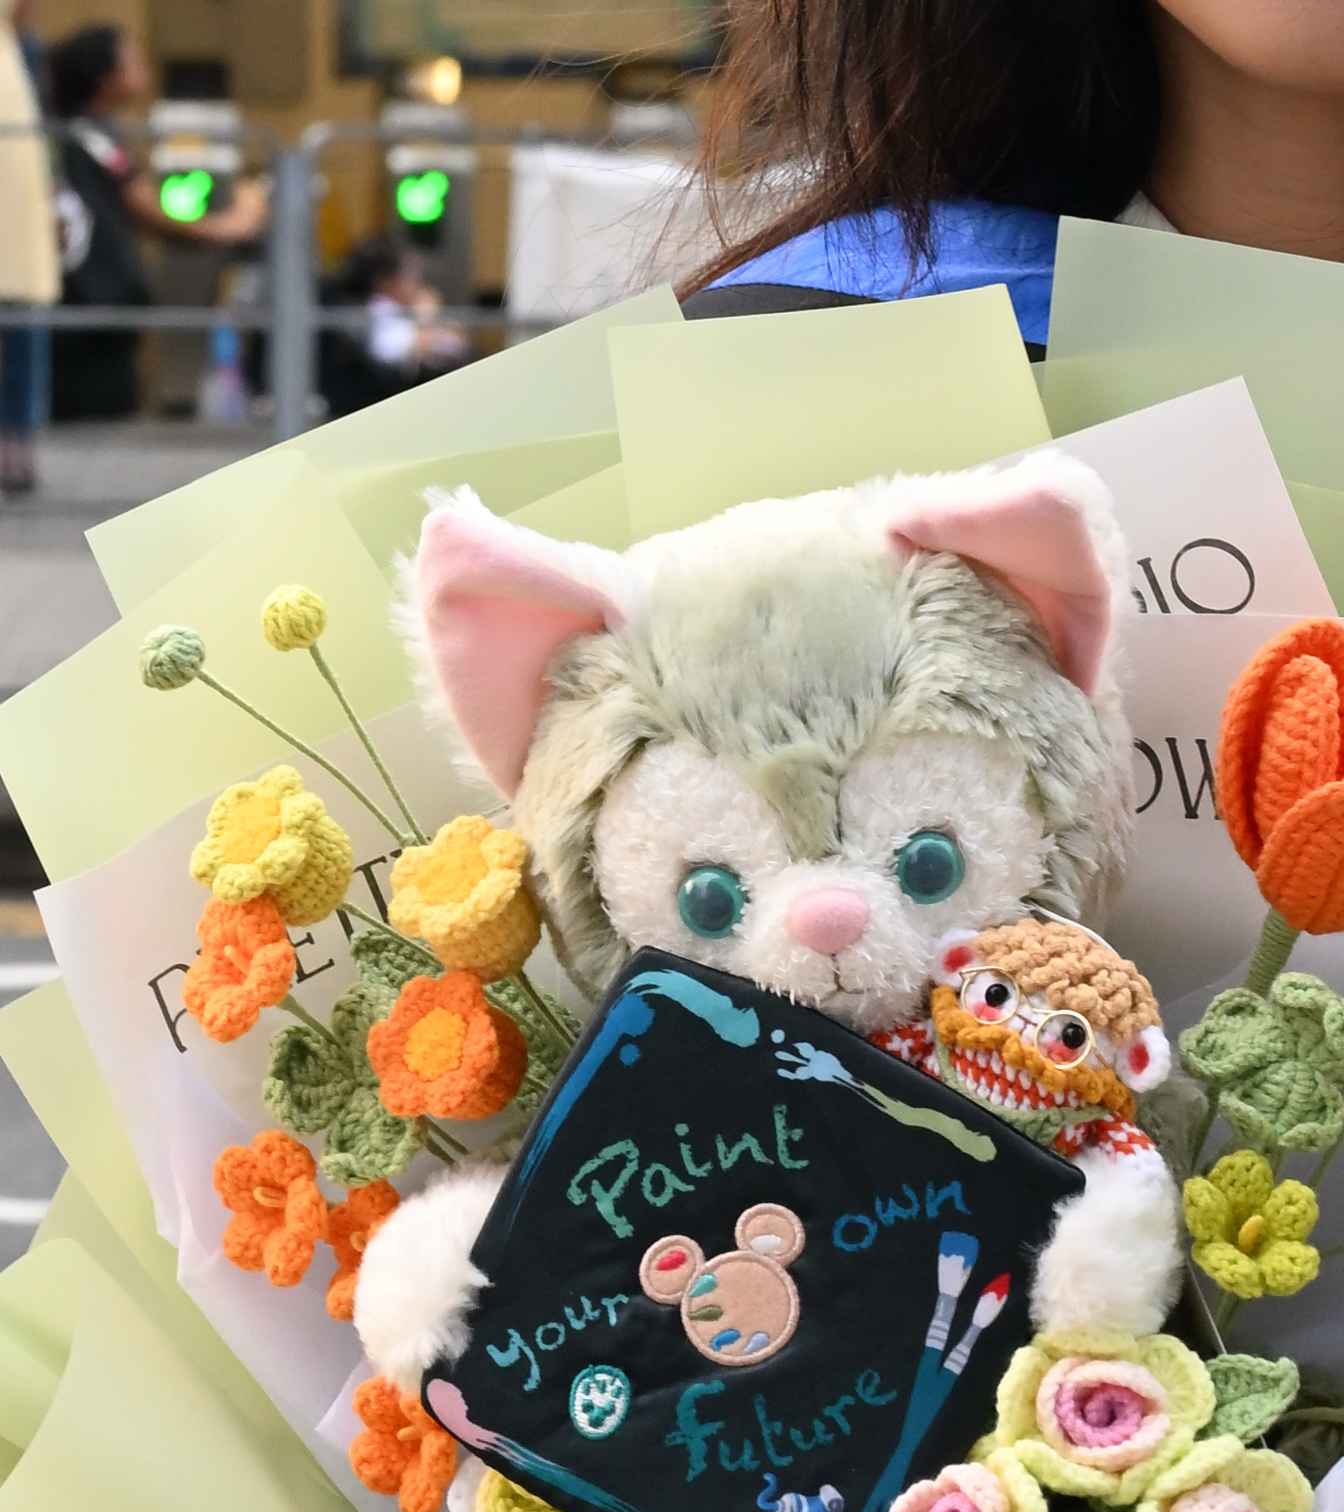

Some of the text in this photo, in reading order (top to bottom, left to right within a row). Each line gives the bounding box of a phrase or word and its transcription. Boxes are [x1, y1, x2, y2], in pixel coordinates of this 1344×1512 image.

[567, 1104, 809, 1238] Paint
[486, 1180, 971, 1391] your own
